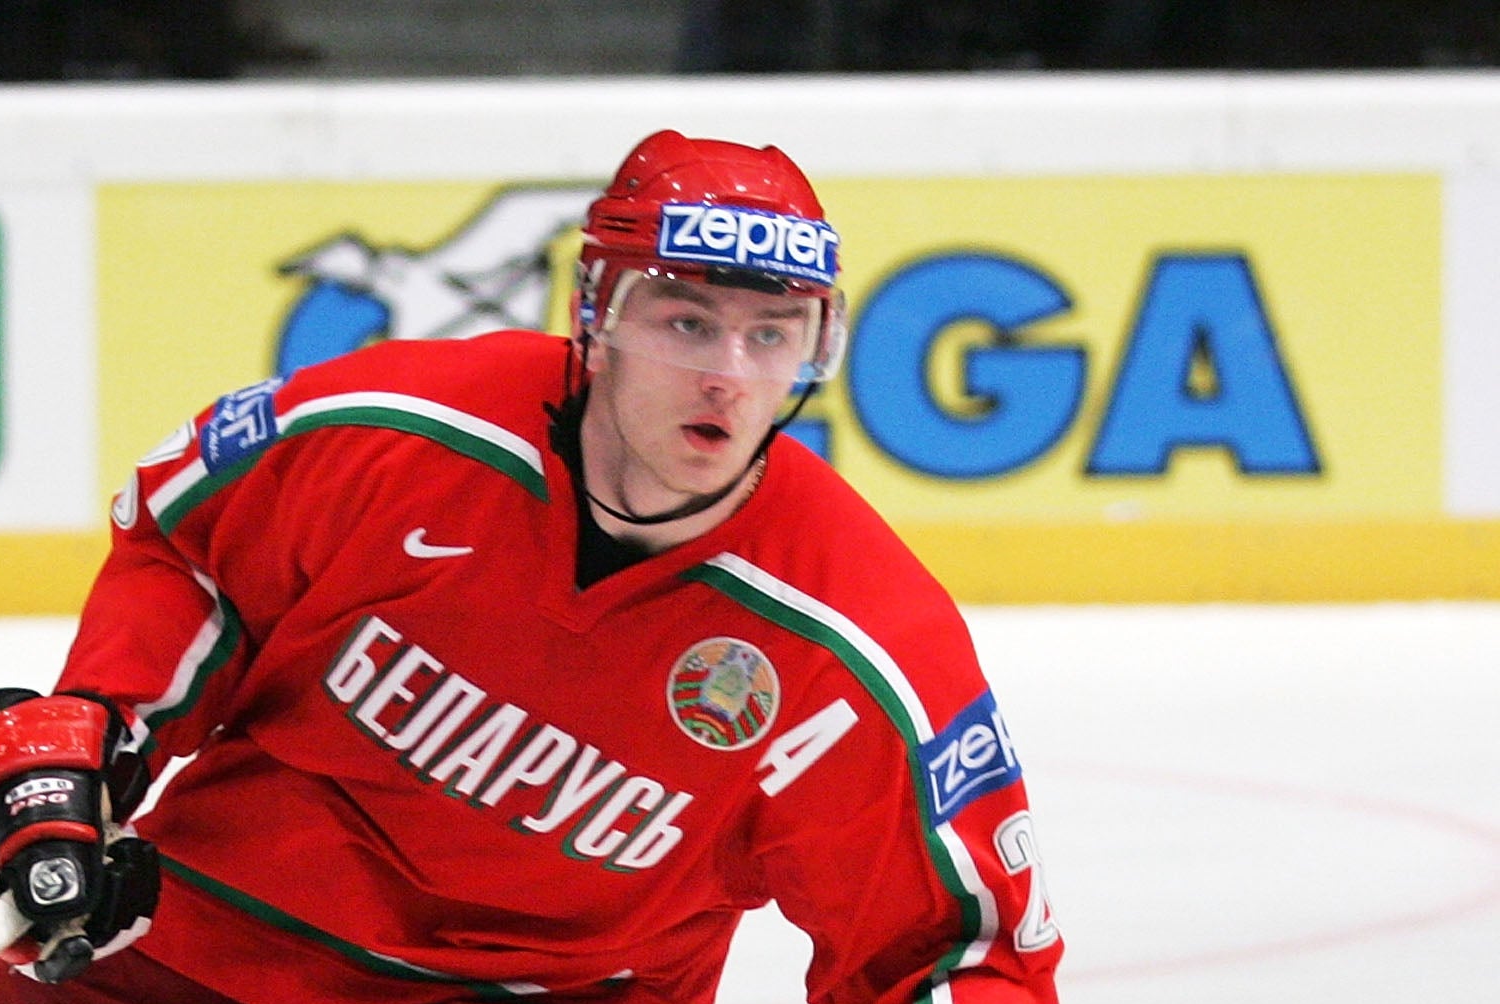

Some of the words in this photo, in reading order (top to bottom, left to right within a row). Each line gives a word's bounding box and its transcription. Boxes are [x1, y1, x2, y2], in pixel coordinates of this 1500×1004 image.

[662, 205, 840, 271] zepter
[776, 246, 1324, 482] GA
[323, 614, 694, 870] БЕЛАРУСЬ
[755, 697, 860, 798] A
